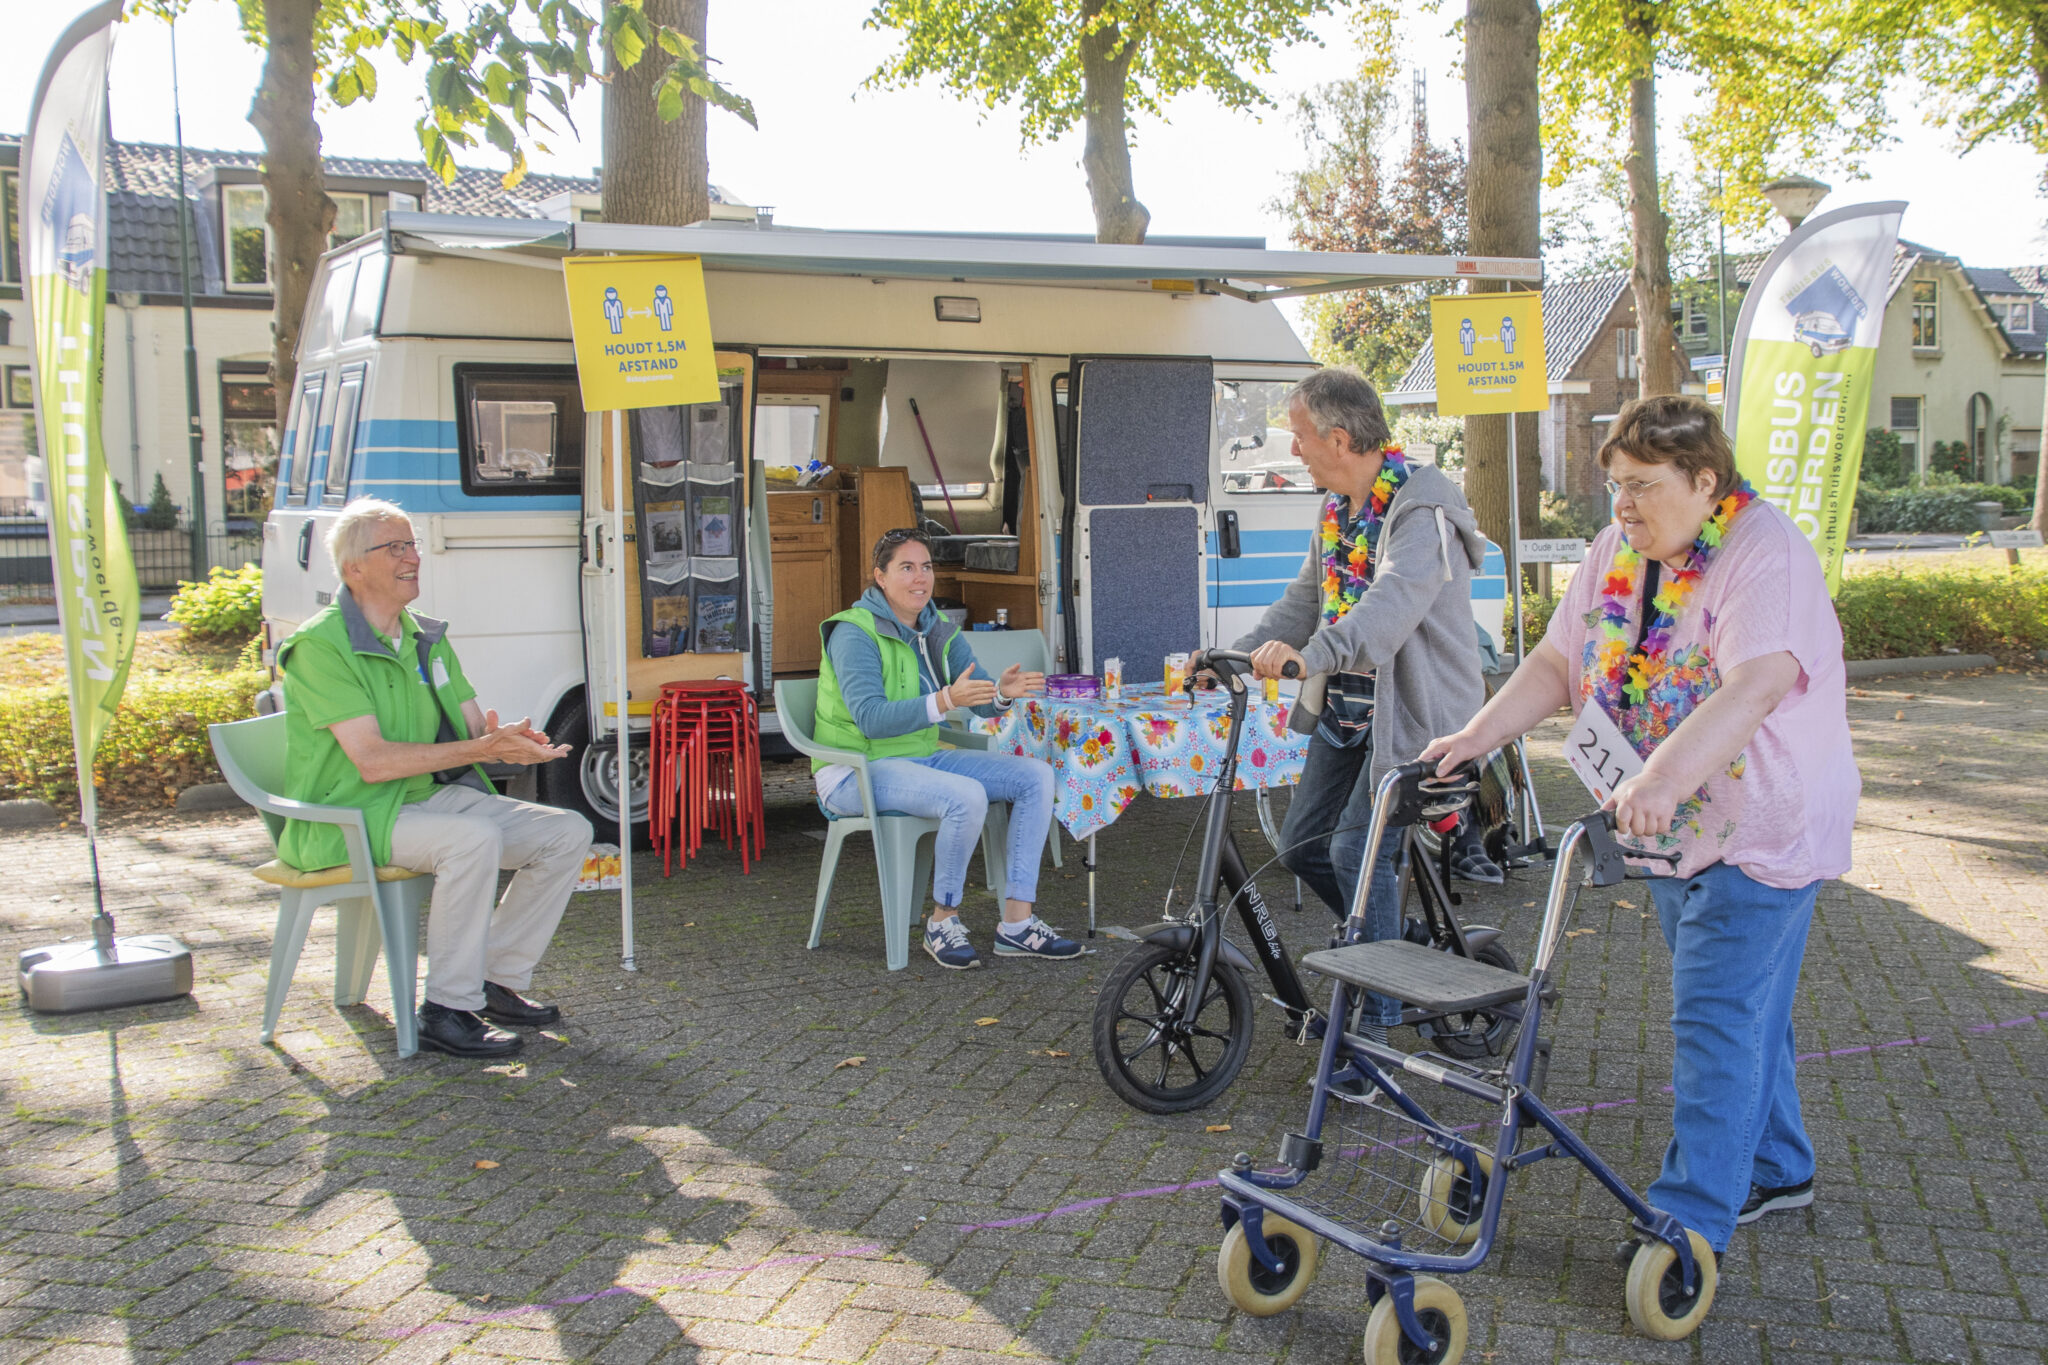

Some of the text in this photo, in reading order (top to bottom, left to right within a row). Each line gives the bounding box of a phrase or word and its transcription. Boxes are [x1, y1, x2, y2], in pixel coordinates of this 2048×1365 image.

[1779, 257, 1833, 304] THUISBUS
[1830, 268, 1868, 317] WOERDEN
[604, 339, 687, 356] HOUDT 1,5M
[618, 358, 679, 373] AFSTAND
[1457, 360, 1525, 373] HOUDT 1,5M
[1467, 375, 1517, 386] AFSTAND
[1793, 371, 1844, 542] OERDEN
[1531, 542, 1552, 552] Oude
[1578, 727, 1625, 793] 211
[1243, 881, 1281, 960] NRG bike
